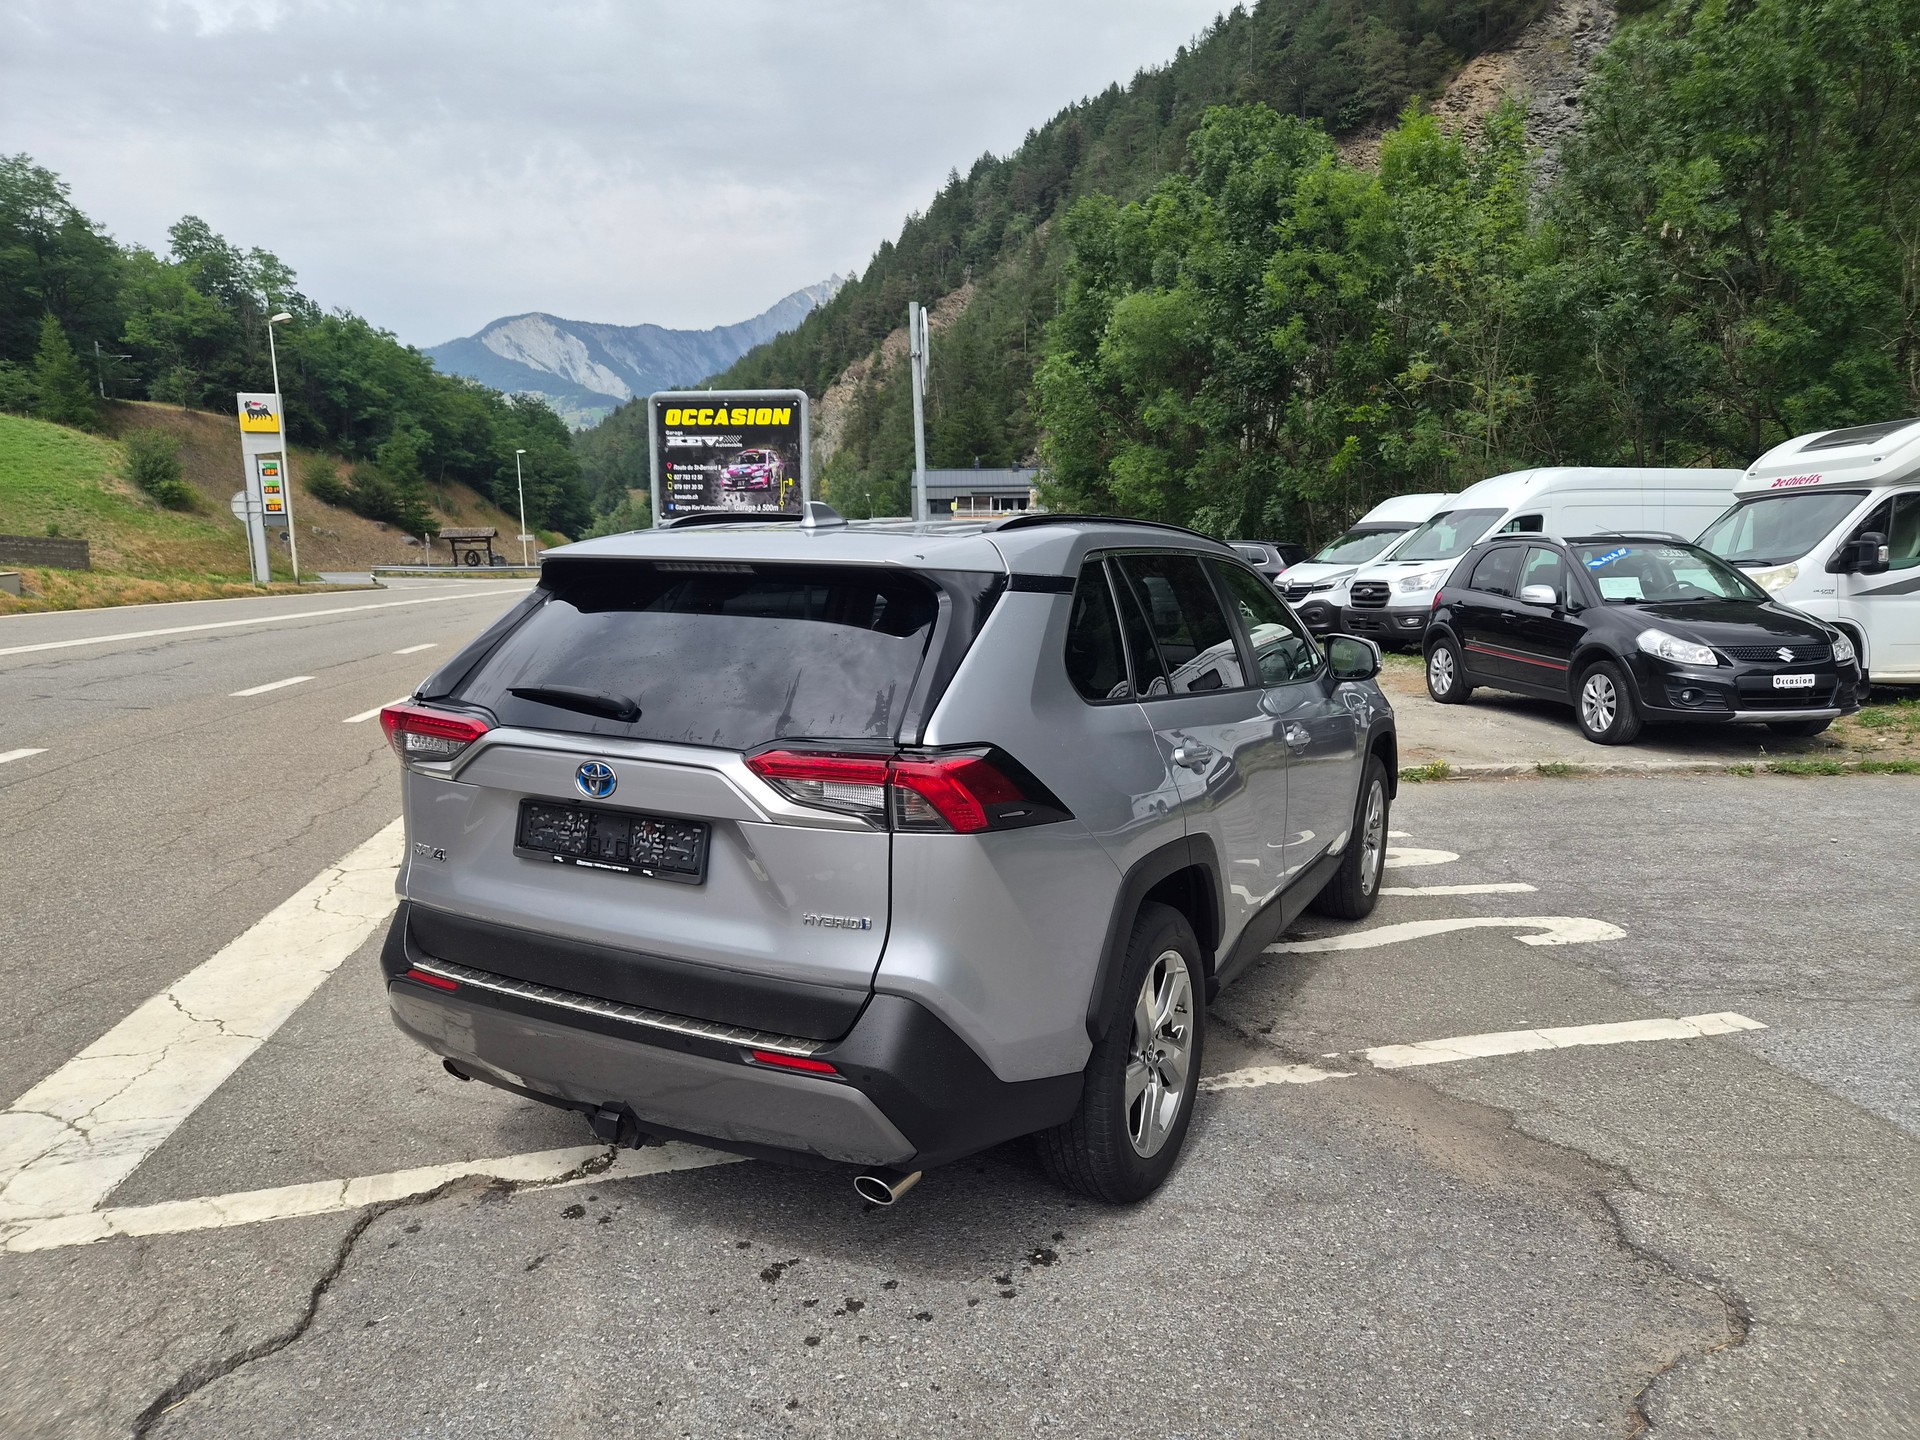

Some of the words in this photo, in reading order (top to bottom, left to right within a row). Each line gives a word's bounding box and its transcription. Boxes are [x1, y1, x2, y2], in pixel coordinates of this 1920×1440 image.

[665, 408, 792, 426] OCCASION
[734, 504, 757, 512] Garage
[1775, 675, 1813, 686] Occasion
[802, 912, 861, 929] HYBRID
